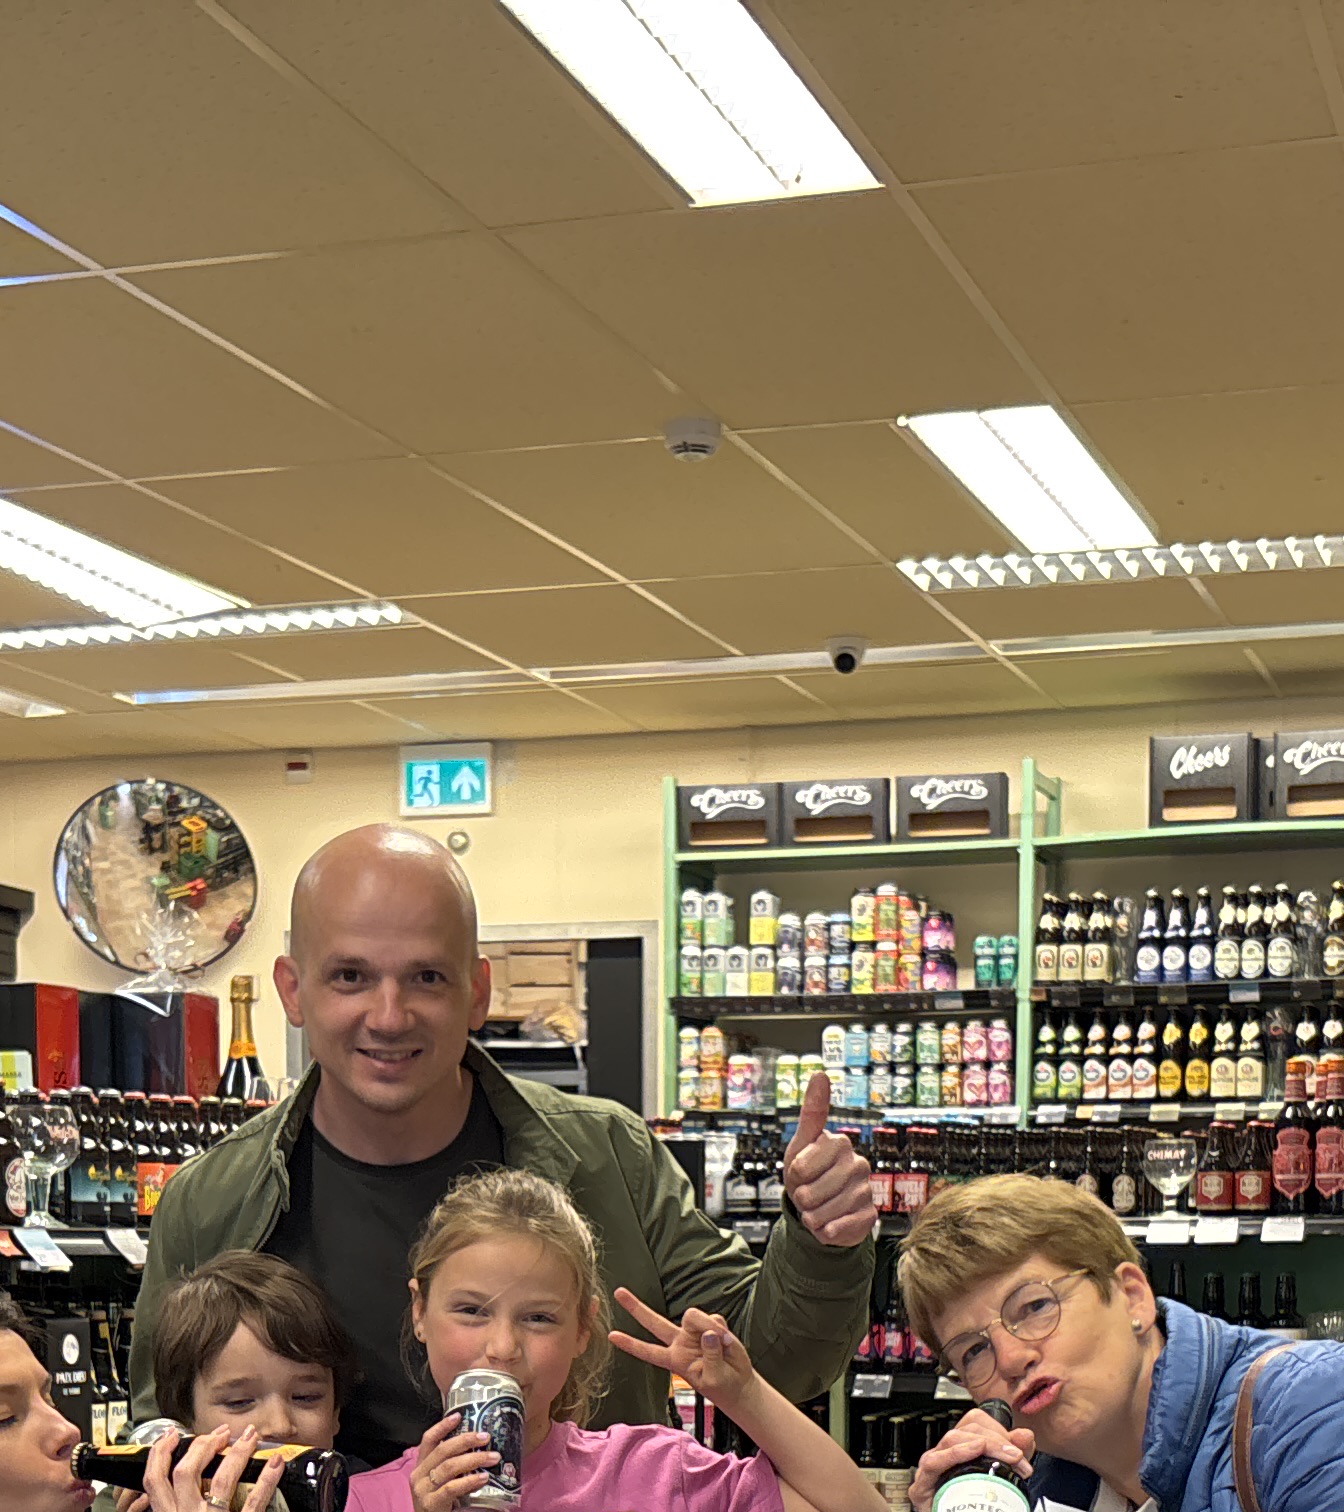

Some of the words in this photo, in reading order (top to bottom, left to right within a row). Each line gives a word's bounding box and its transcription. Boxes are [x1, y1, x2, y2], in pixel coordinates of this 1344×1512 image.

[1169, 743, 1230, 779] Cheers
[690, 788, 765, 819] Cheers
[795, 784, 872, 815] Cheers
[910, 777, 989, 810] Cheers
[1147, 1150, 1187, 1161] CHIMAY
